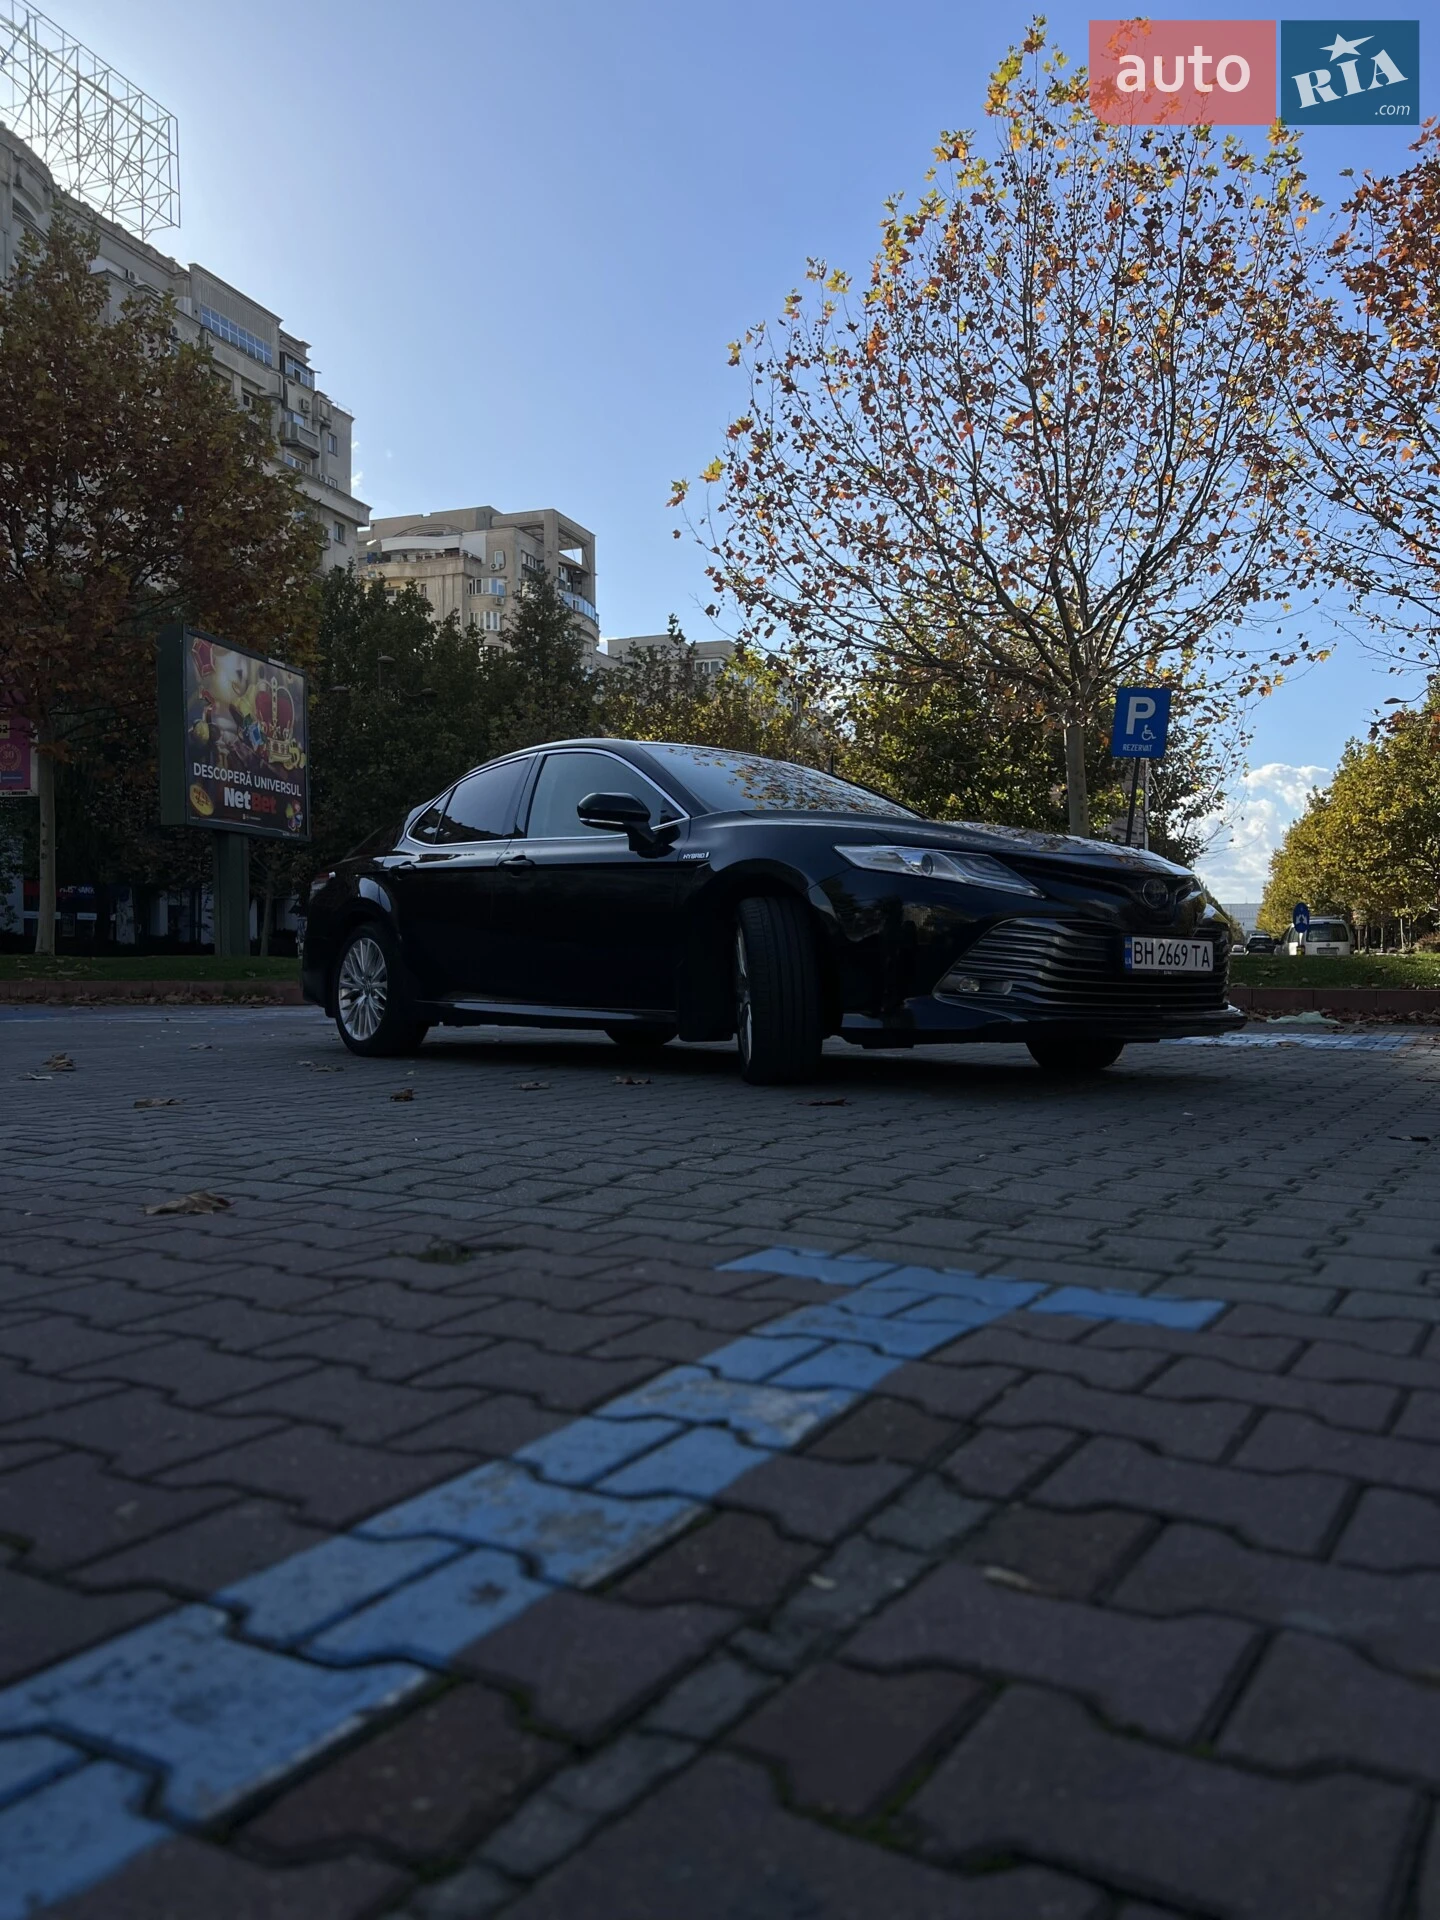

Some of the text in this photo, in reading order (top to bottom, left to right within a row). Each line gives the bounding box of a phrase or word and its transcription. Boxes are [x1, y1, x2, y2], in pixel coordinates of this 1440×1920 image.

[1125, 696, 1156, 735] P
[1122, 743, 1153, 752] REZERVAT
[193, 762, 302, 797] DESCOPERĂ UNIVERSUL
[1133, 941, 1211, 968] BH 2669 TA
